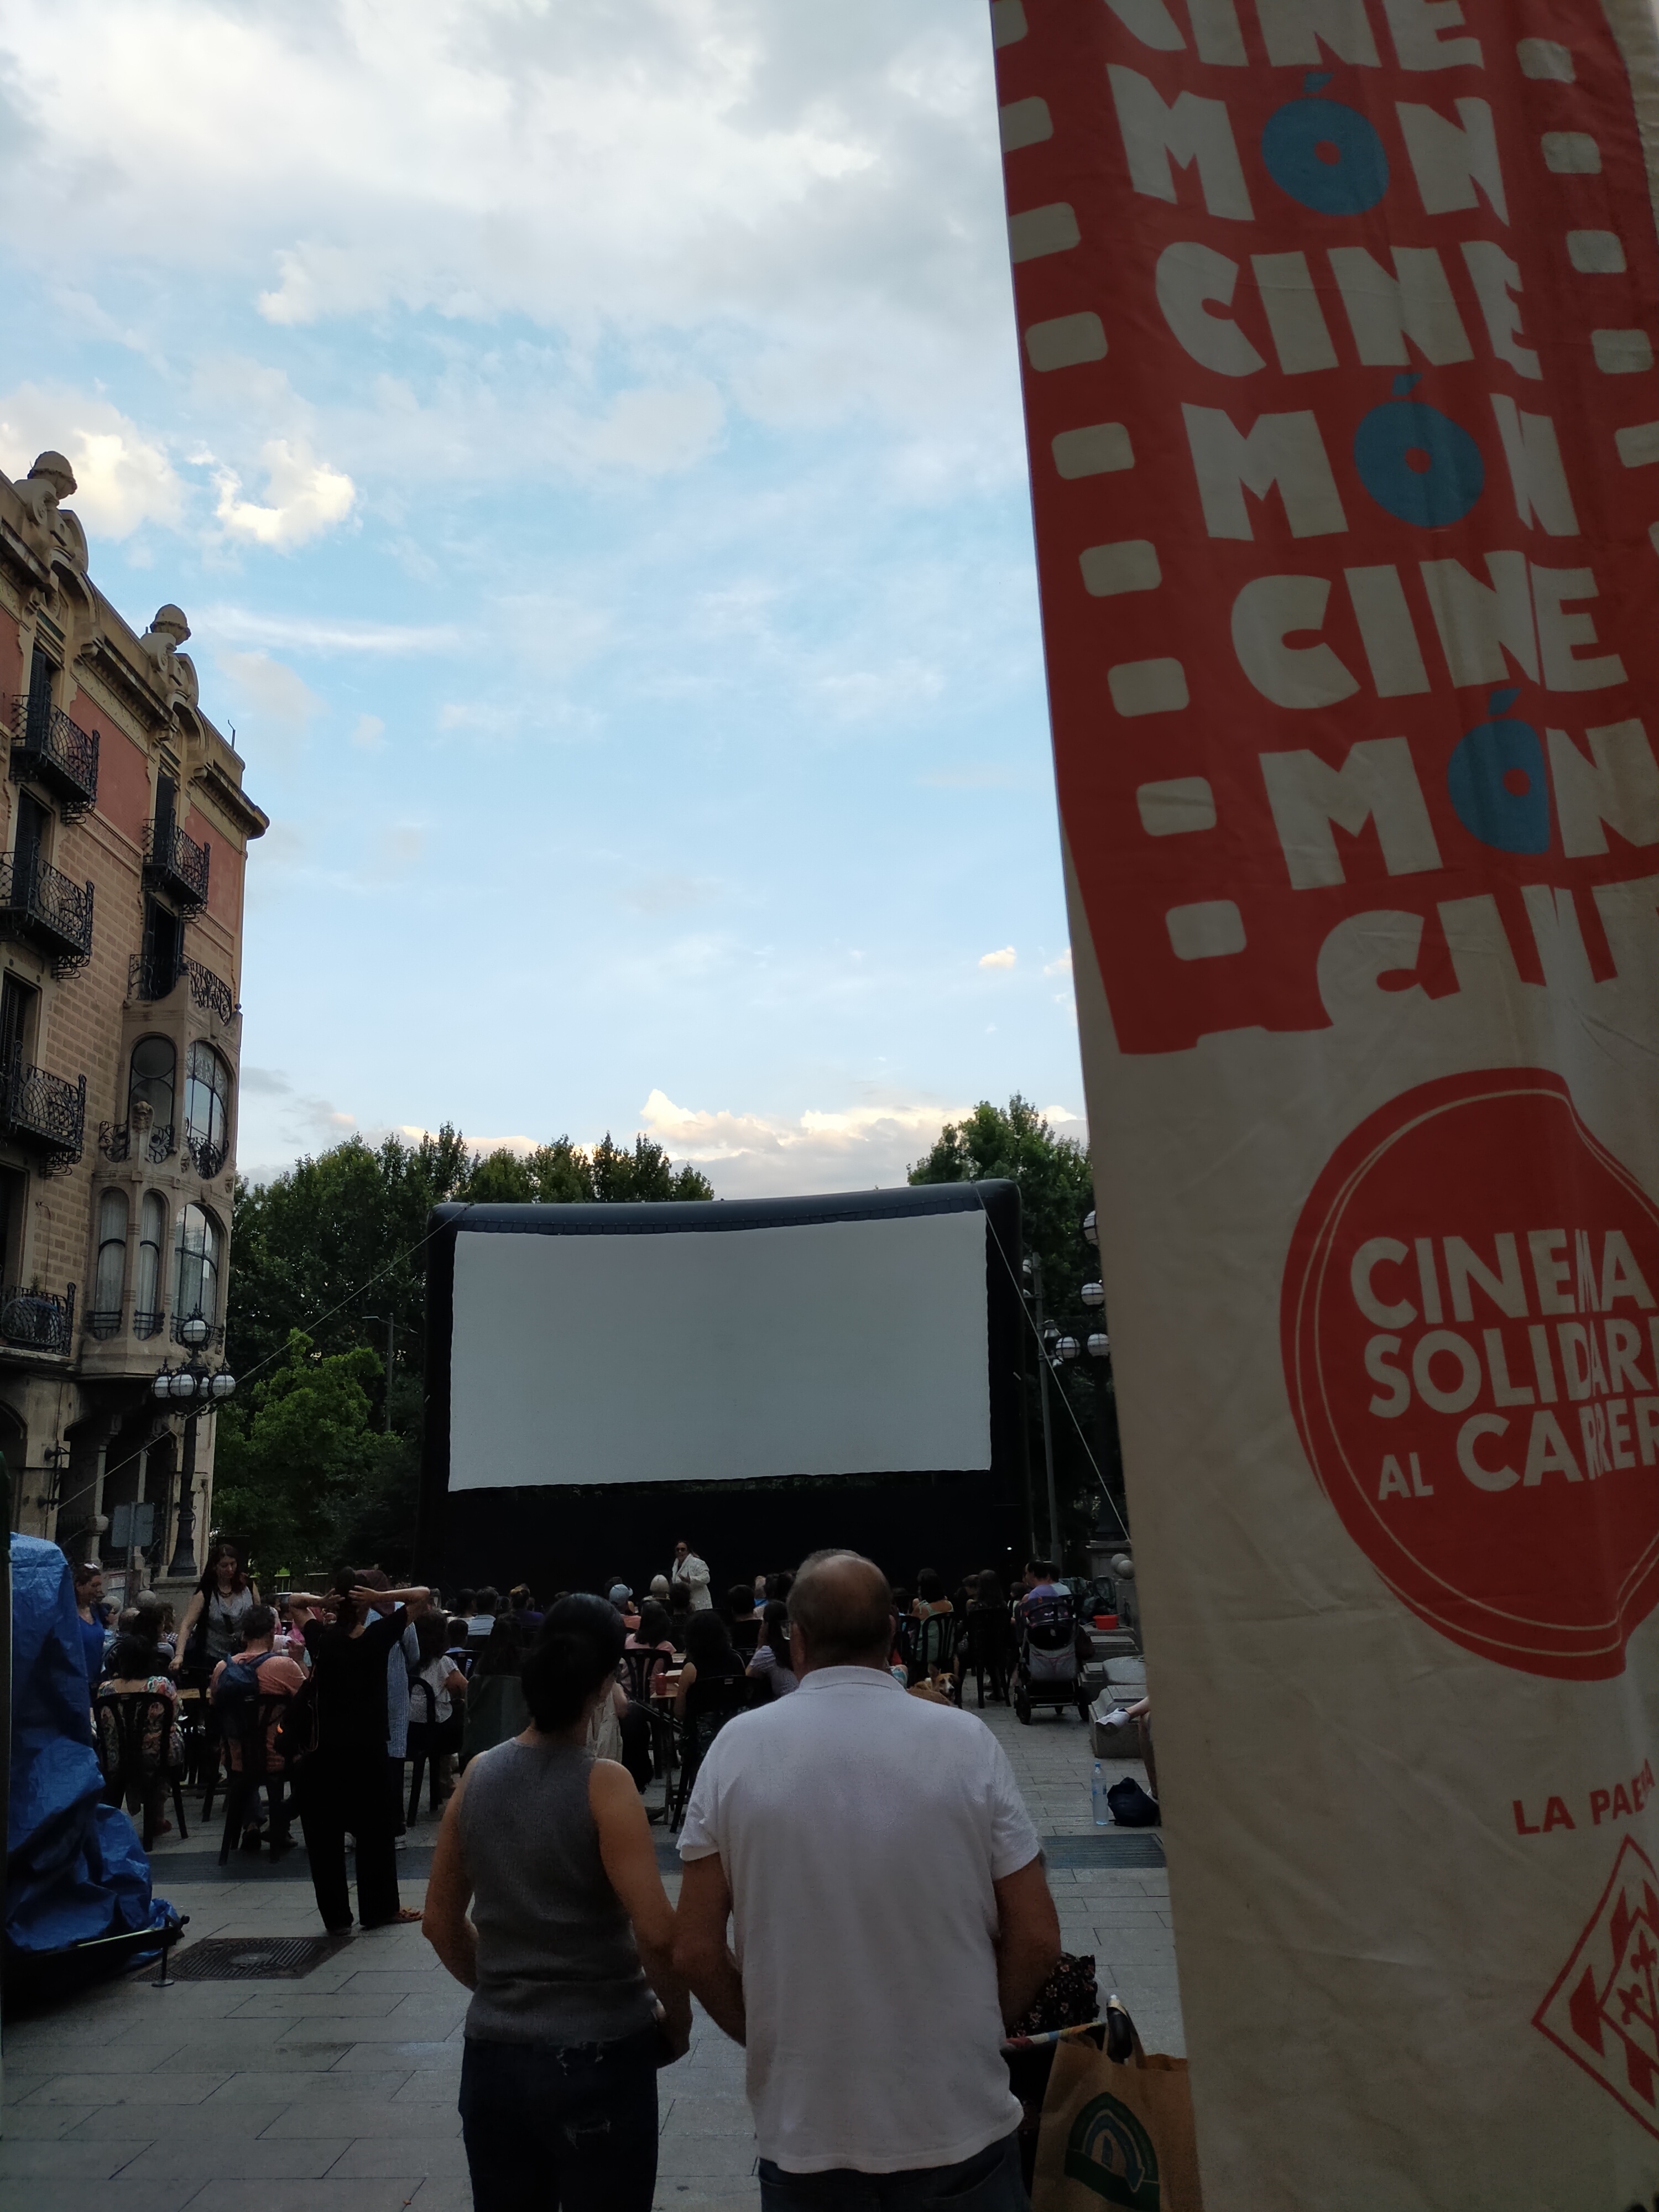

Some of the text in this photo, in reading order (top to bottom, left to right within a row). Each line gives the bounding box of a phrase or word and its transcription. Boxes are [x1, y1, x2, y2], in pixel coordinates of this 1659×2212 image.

[1106, 62, 1510, 227] MÓN
[1156, 242, 1543, 380] CINE
[1181, 373, 1580, 541] MÓN
[1231, 550, 1629, 709] CINE
[1259, 688, 1659, 890] MÓN
[1350, 1228, 1657, 1328] CINEMA
[1378, 1452, 1434, 1500] AL
[1512, 1796, 1576, 1835] LA
